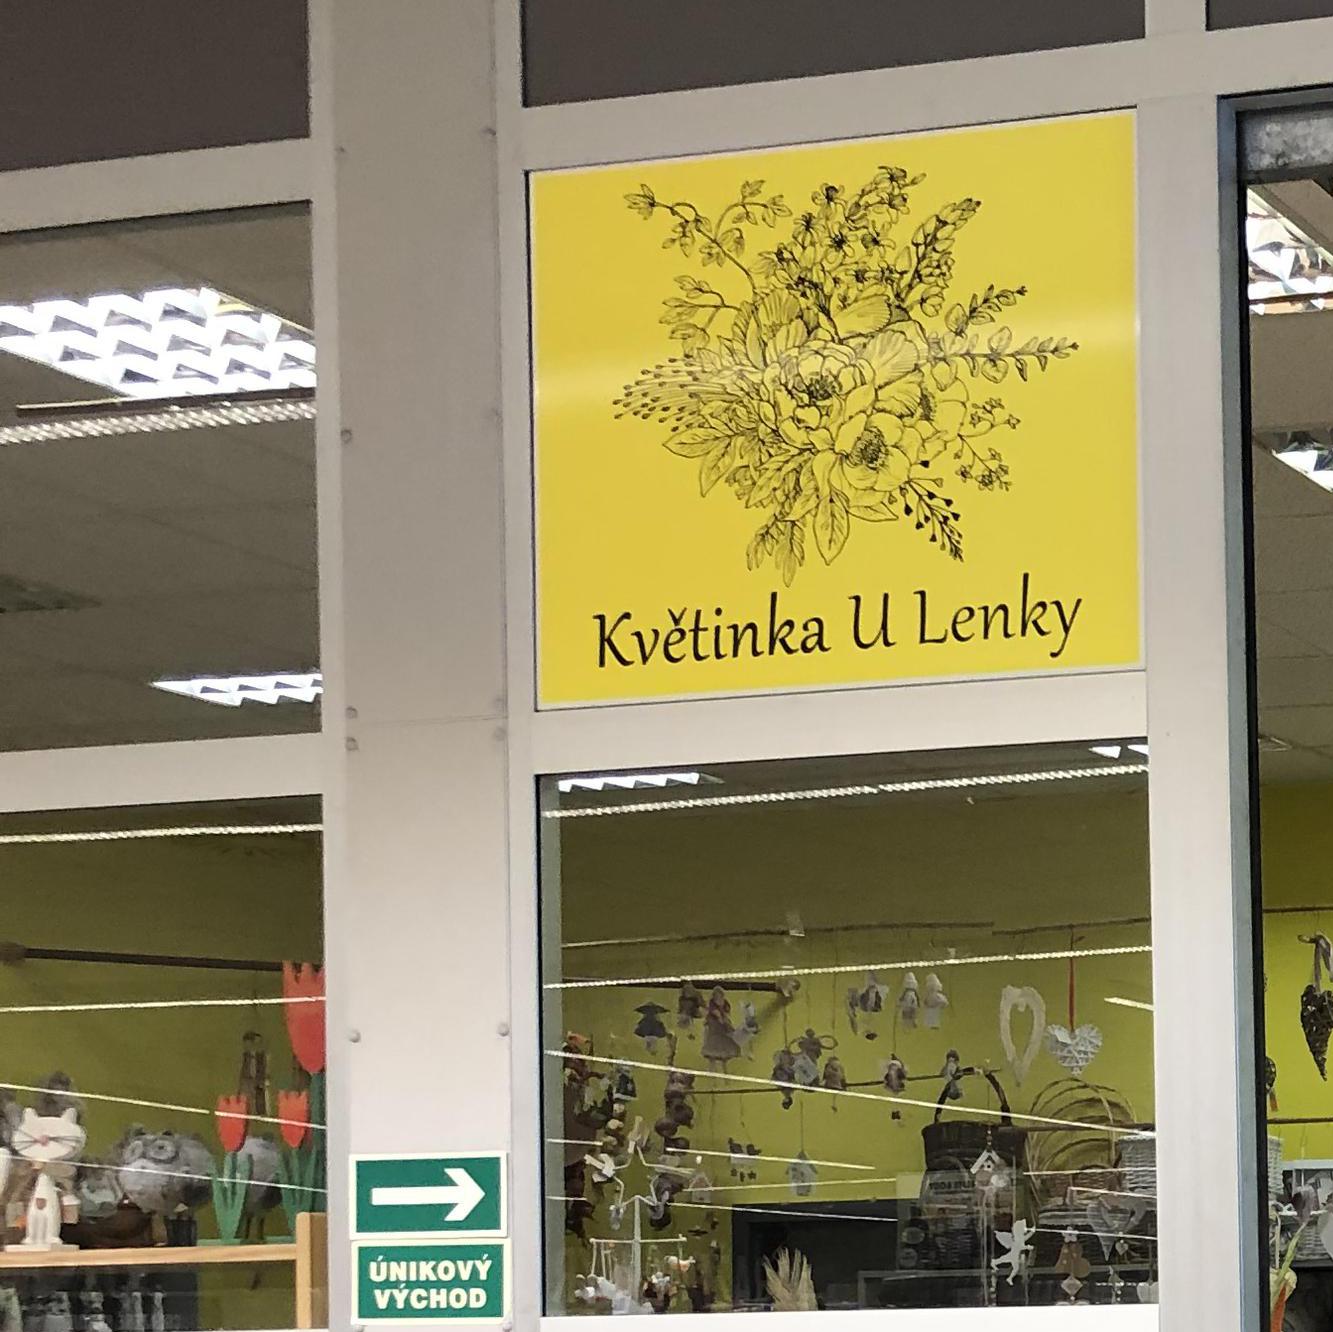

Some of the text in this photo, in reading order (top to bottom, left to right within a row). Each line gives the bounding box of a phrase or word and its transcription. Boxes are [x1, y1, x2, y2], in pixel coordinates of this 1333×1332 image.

[593, 572, 1083, 668] Květinka U Lenky
[368, 1253, 493, 1282] ÚNIKOVÝ
[374, 1284, 487, 1310] VÝCHOD
